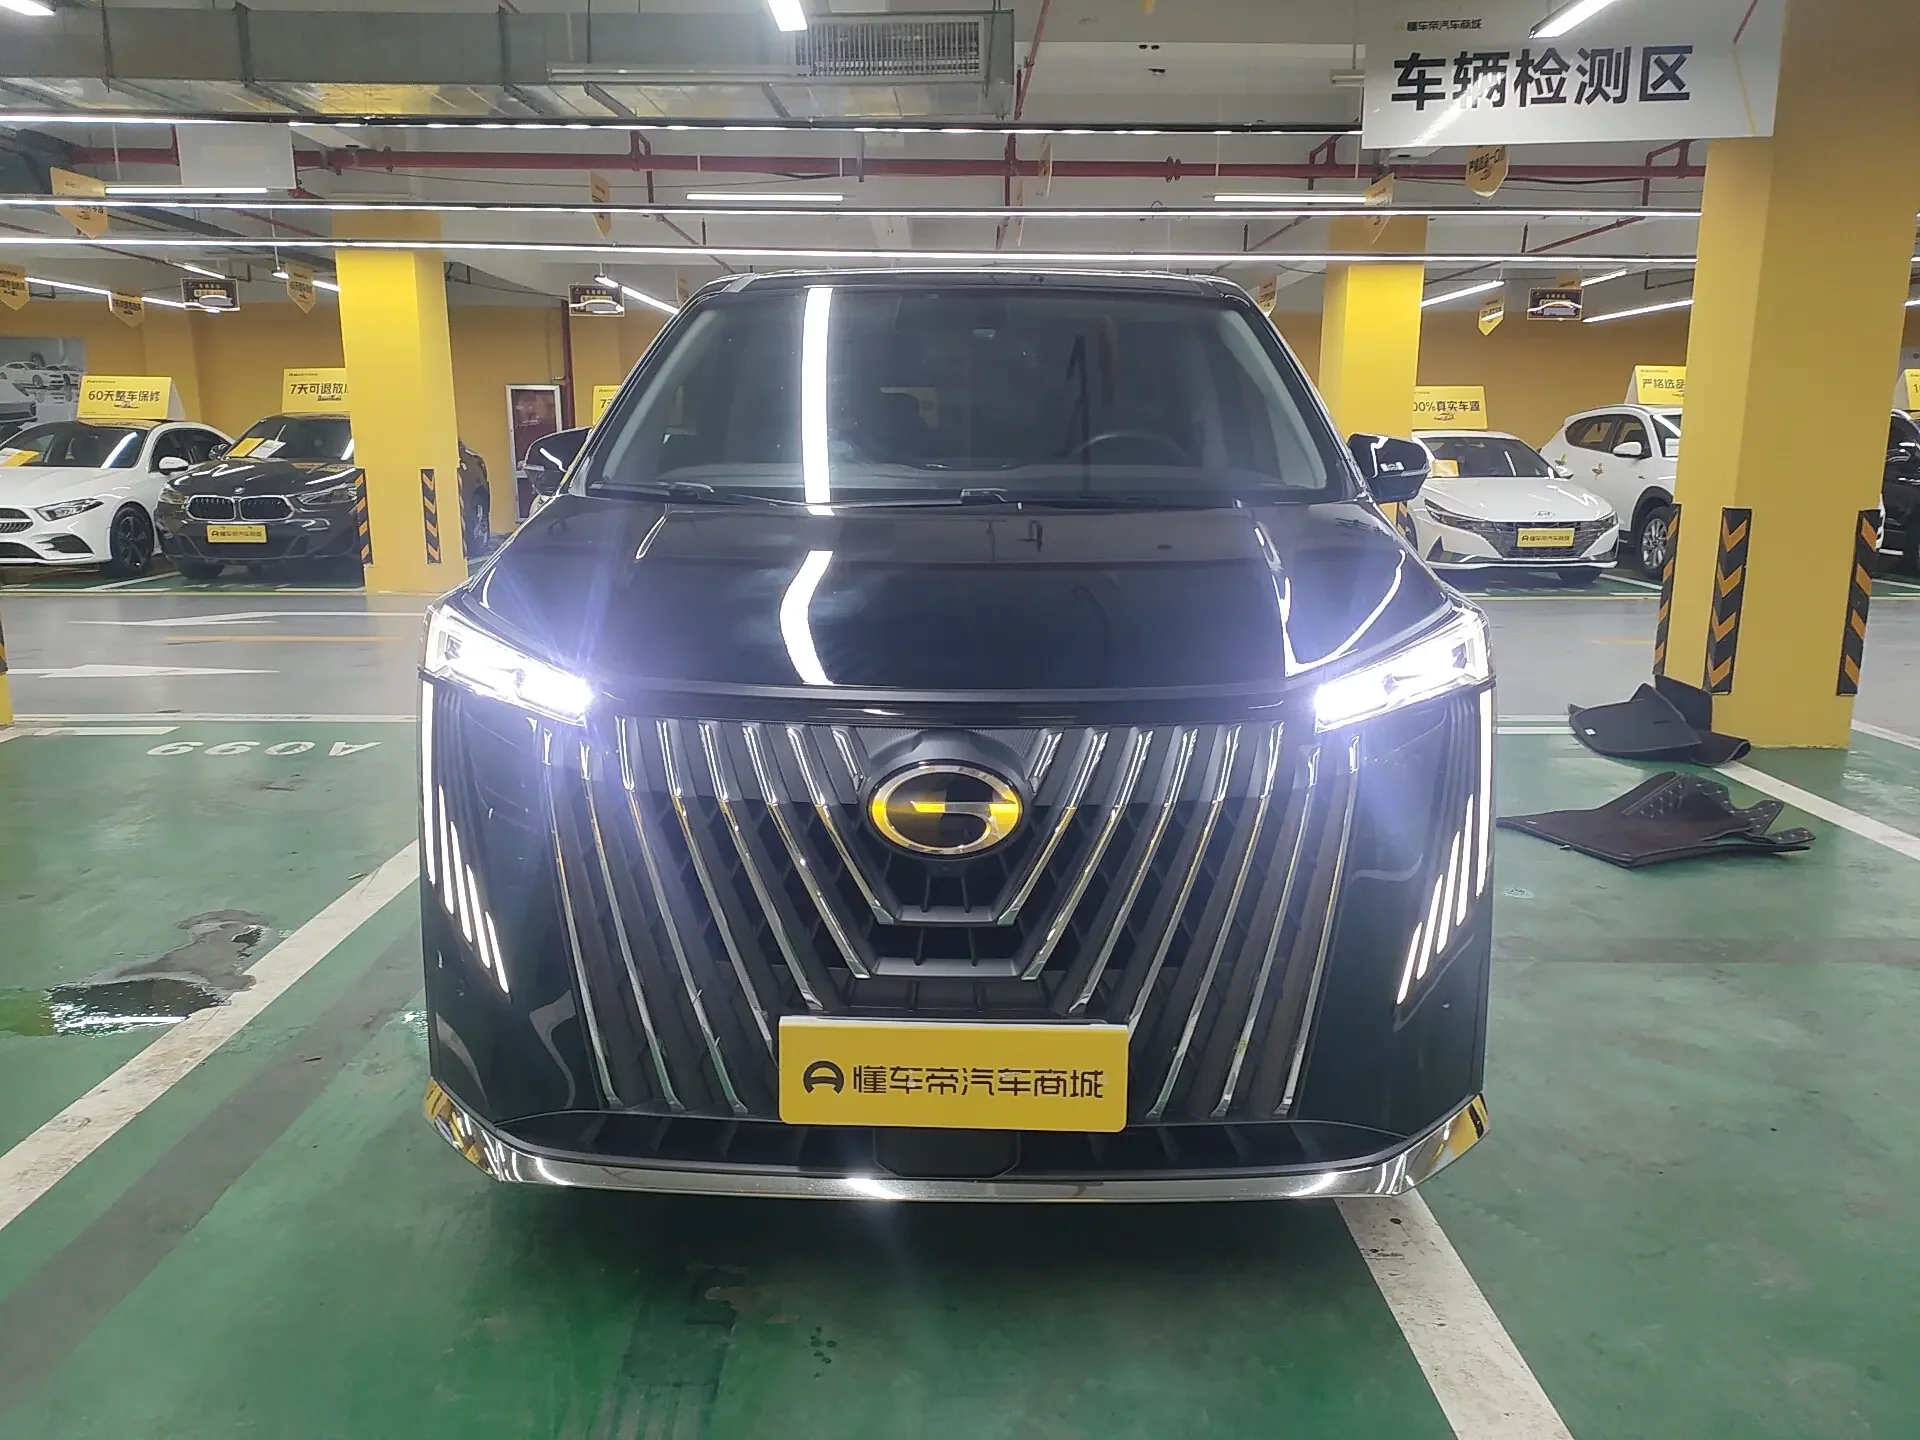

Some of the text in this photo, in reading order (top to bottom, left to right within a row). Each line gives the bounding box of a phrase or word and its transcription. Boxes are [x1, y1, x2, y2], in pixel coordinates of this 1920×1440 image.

[1407, 18, 1482, 32] 懂车帝汽车商城
[1391, 45, 1694, 111] 车辆检测区
[290, 382, 349, 395] 7天可退放
[88, 390, 161, 403] 60天整车保修
[147, 741, 383, 756] A099
[852, 1064, 1104, 1099] 懂车帝汽车商城
